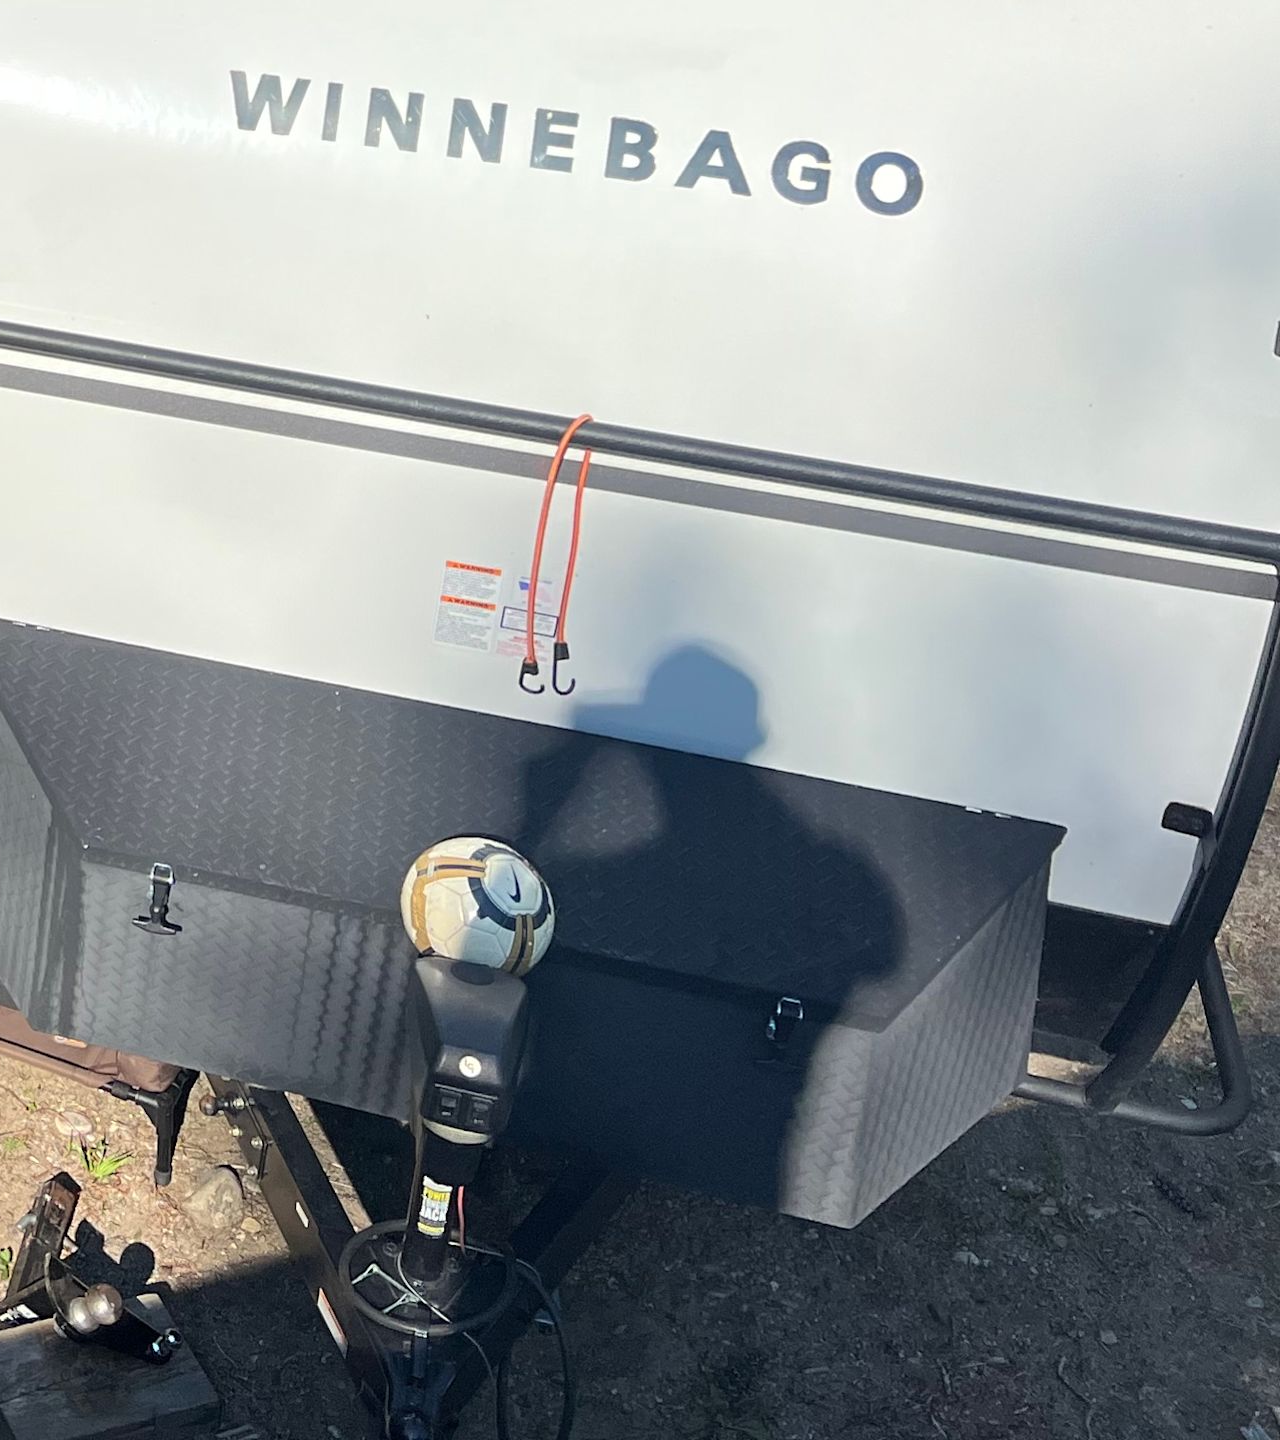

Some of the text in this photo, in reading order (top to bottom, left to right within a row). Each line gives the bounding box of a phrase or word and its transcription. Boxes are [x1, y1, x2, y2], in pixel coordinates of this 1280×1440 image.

[229, 70, 924, 216] WINNEBAGO
[459, 564, 495, 575] WARNING
[454, 598, 490, 609] WARNING
